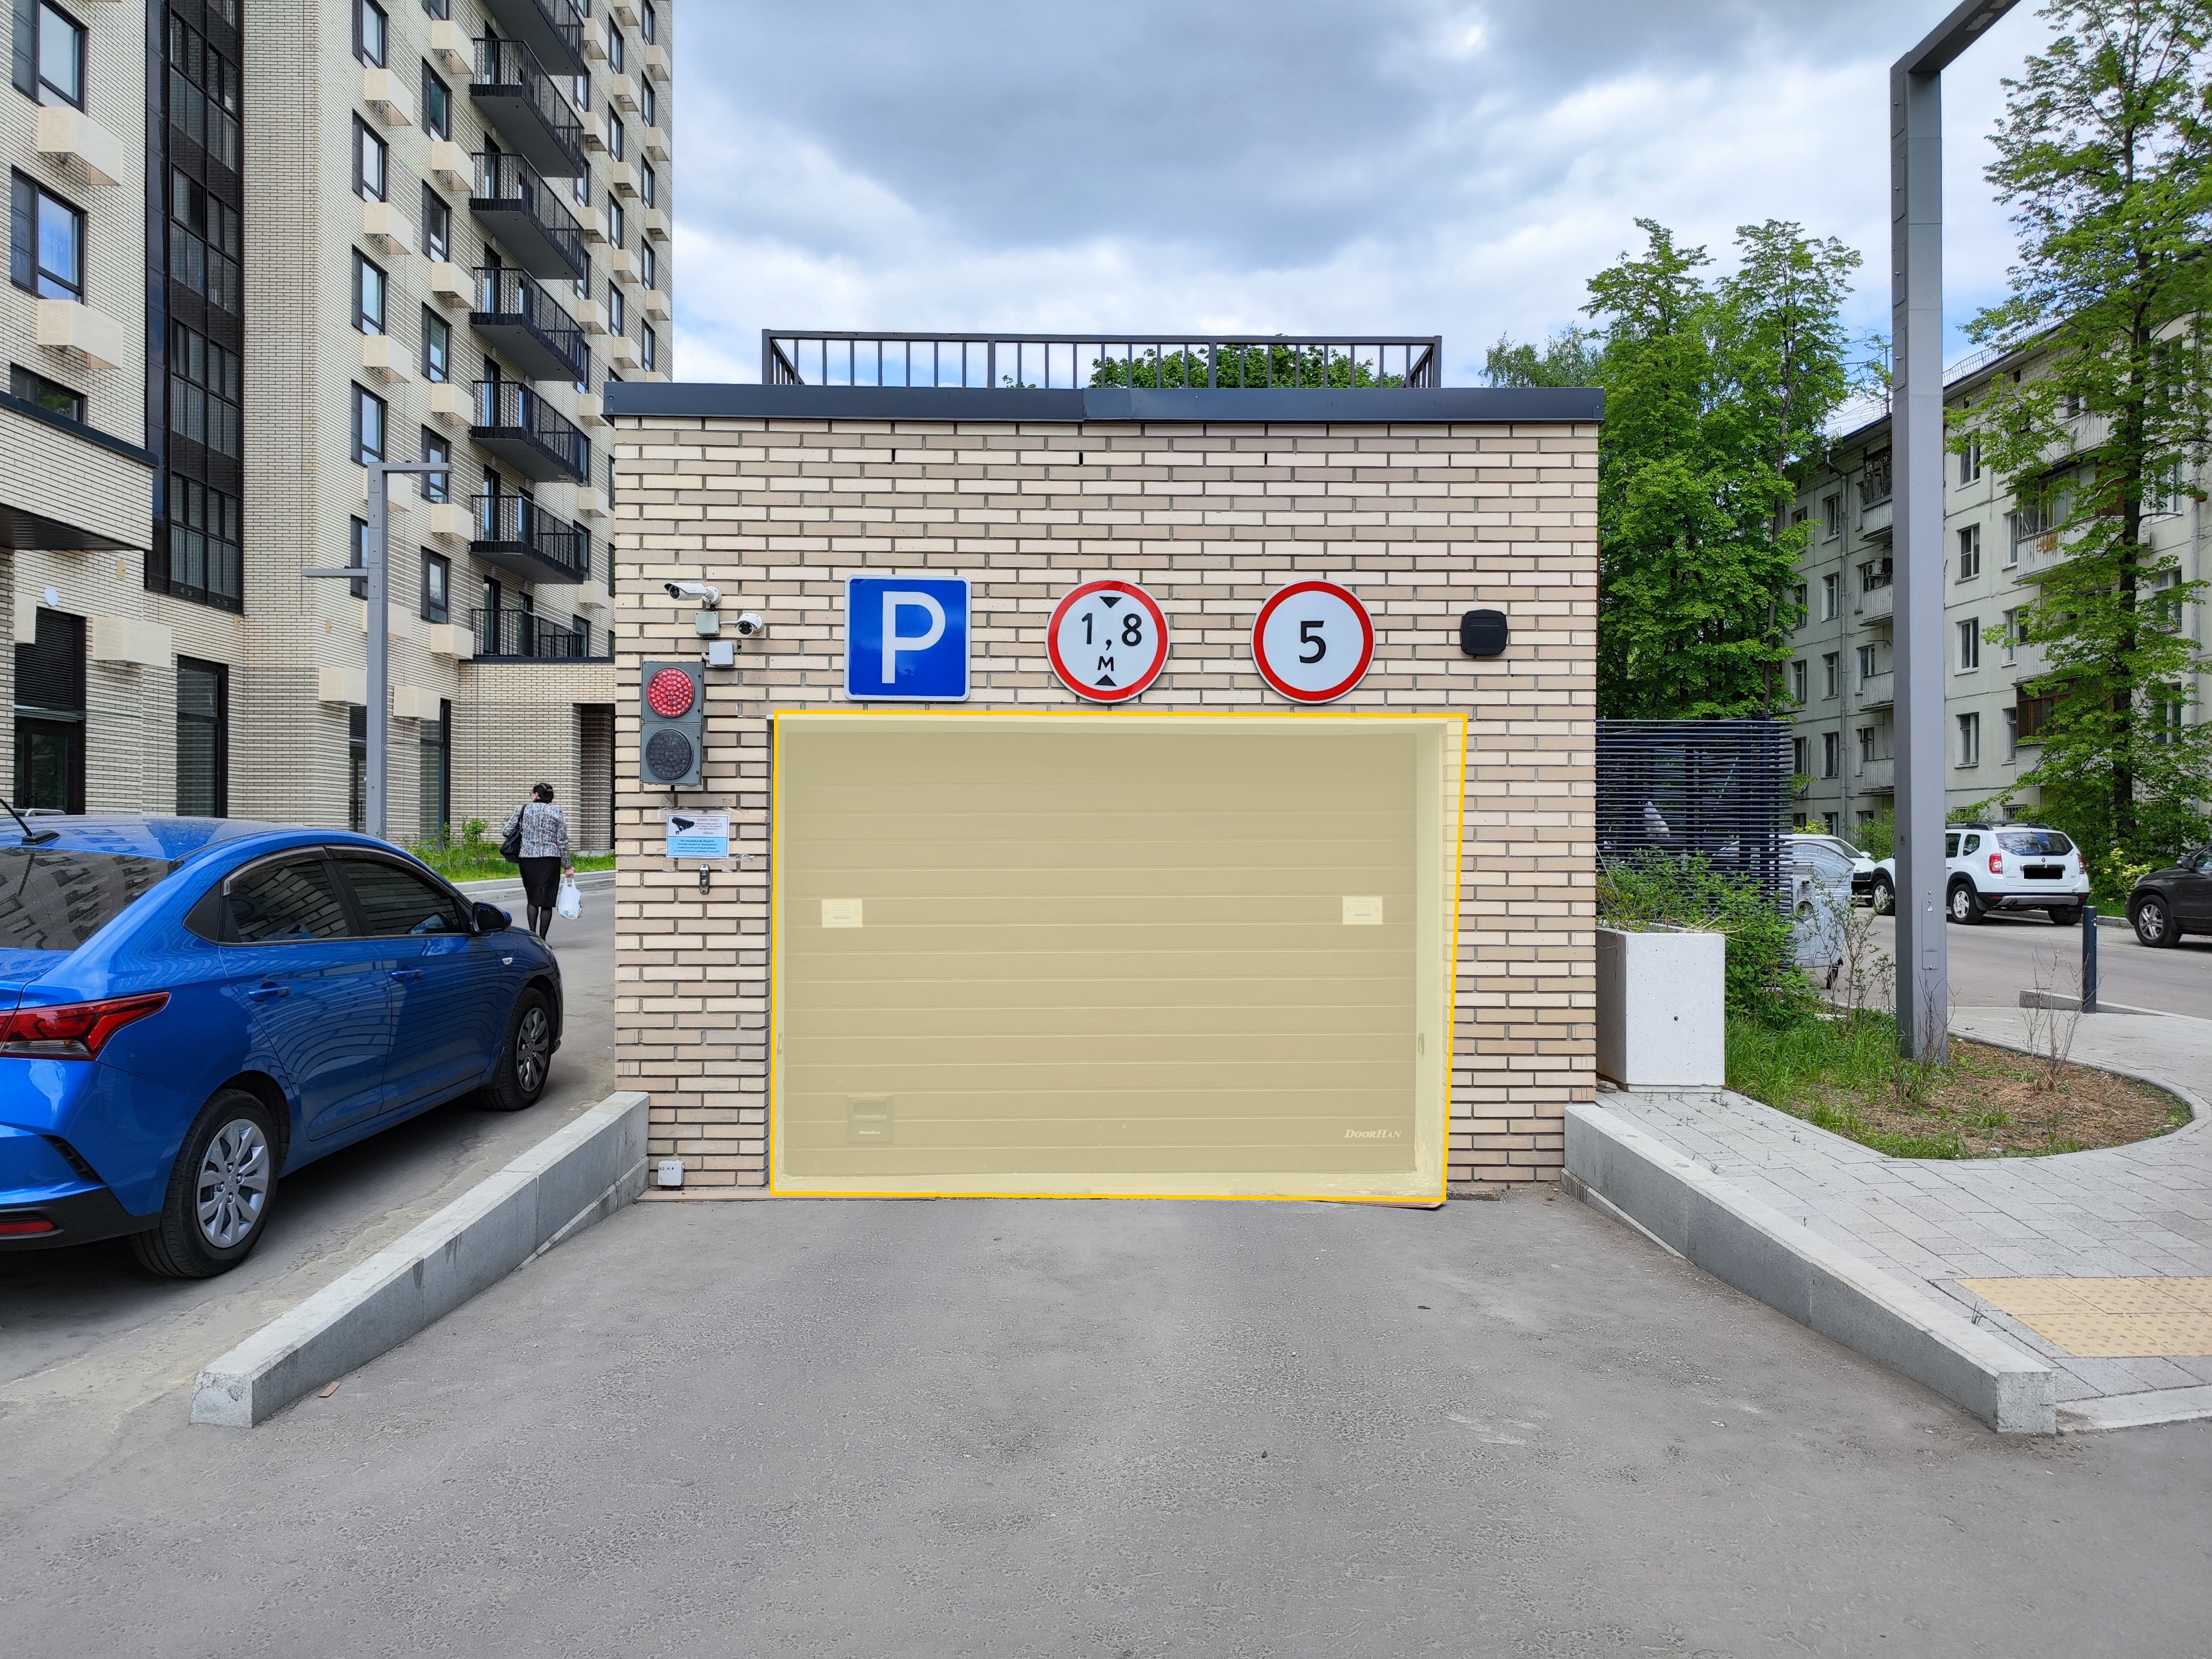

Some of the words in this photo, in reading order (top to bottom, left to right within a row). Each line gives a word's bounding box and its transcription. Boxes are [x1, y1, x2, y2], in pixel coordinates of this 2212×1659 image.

[882, 591, 946, 684] P
[1081, 613, 1142, 651] 1,8
[1299, 621, 1326, 664] 5
